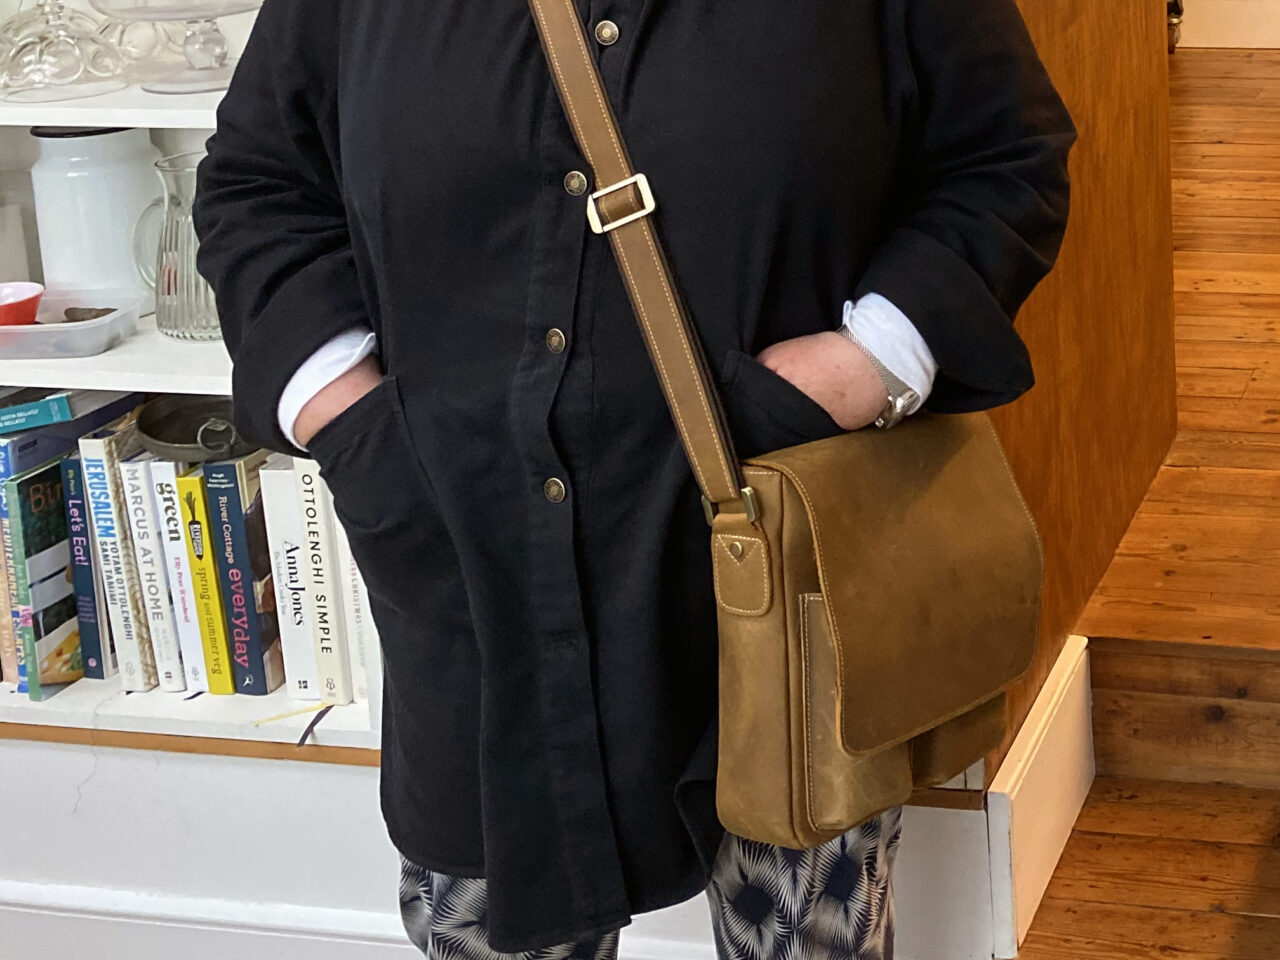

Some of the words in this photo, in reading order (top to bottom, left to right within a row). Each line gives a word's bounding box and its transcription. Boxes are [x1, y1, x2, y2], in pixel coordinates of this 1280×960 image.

[68, 500, 85, 531] Let's
[84, 457, 117, 538] JERUSALEM
[126, 468, 149, 540] MARCUS
[155, 482, 181, 542] green
[218, 496, 229, 523] River
[73, 536, 89, 565] Eat!
[100, 541, 111, 566] SAMI
[140, 547, 154, 567] AT
[223, 524, 234, 564] Cottage
[284, 541, 300, 584] Anna
[302, 474, 325, 584] OTTOLENGHI
[315, 594, 333, 654] SIMPLE
[105, 570, 118, 605] TAMIMI
[110, 541, 122, 575] YOTAM
[116, 578, 133, 640] OTTOLENGHI
[145, 572, 164, 621] HOME
[196, 567, 210, 600] spring
[228, 568, 251, 669] everyday
[285, 583, 305, 626] Jones
[206, 617, 219, 656] summer
[211, 657, 222, 675] veg
